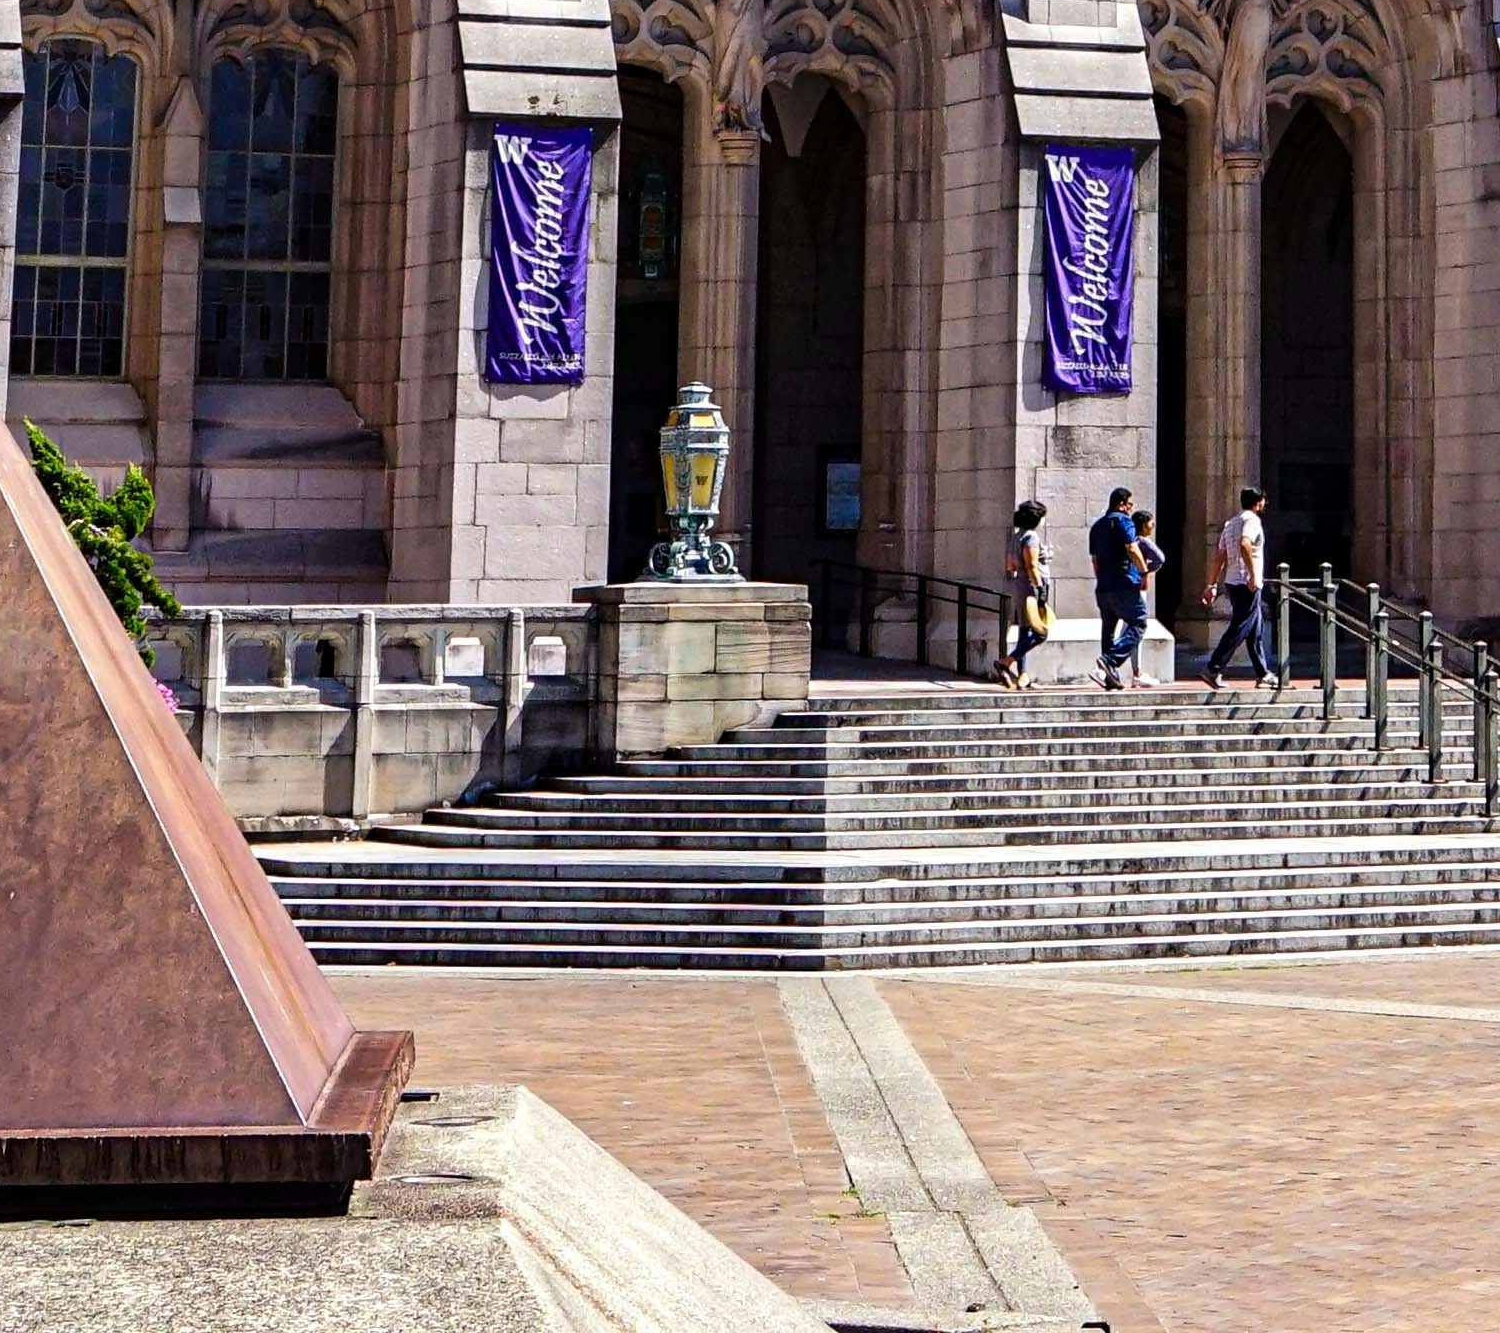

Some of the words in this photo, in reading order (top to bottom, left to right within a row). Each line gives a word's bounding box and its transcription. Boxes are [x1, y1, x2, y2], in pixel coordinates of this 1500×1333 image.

[494, 134, 533, 166] W
[1045, 154, 1080, 184] W
[510, 159, 565, 345] Welcome
[1062, 178, 1110, 356] Welcome
